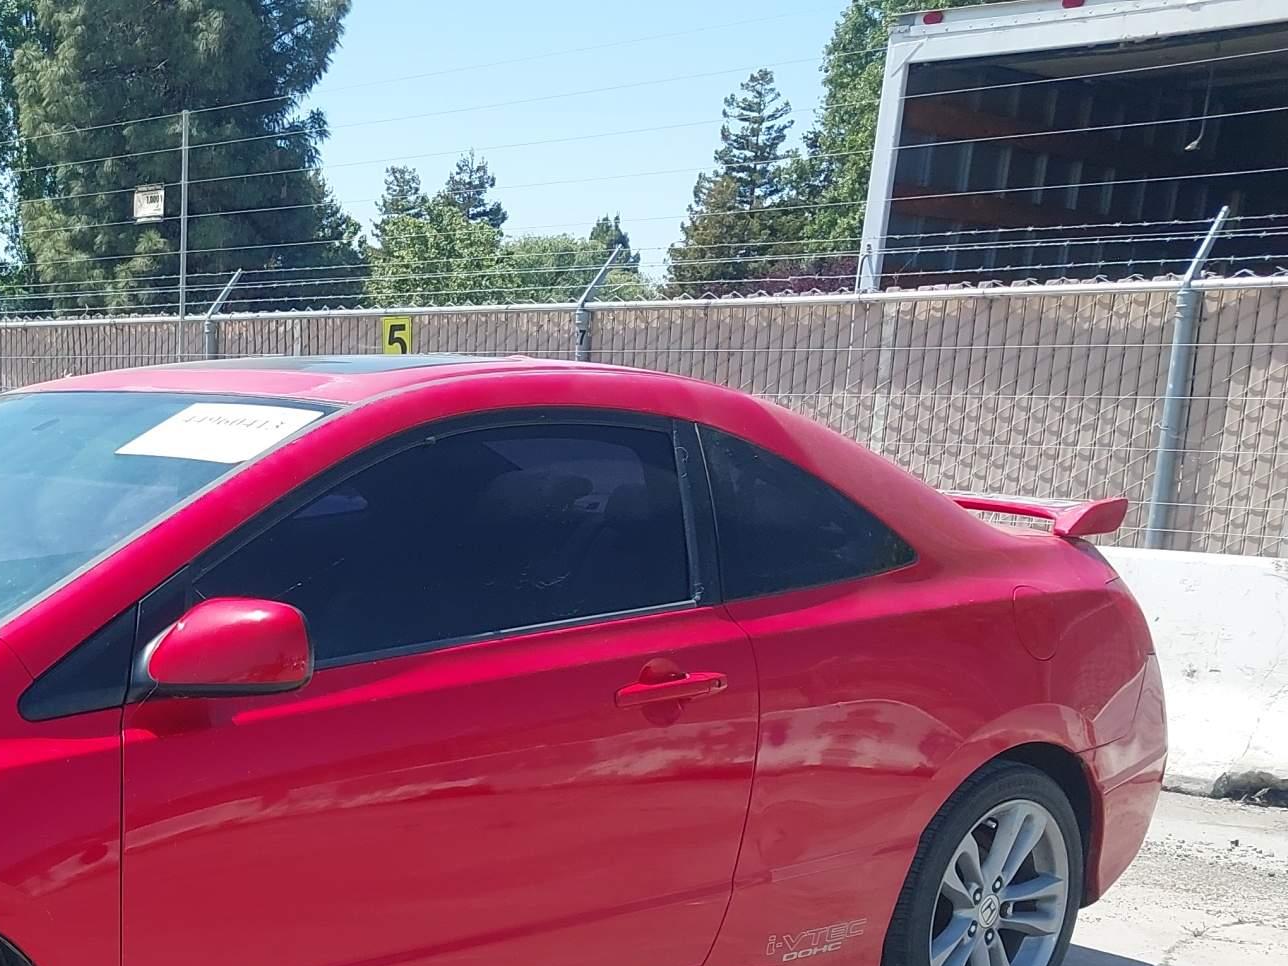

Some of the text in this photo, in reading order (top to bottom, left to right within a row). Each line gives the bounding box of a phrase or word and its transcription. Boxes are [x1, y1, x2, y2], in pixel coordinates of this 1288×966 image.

[388, 324, 408, 354] 5
[766, 918, 868, 956] i-VTEC
[782, 941, 842, 962] DOHC
